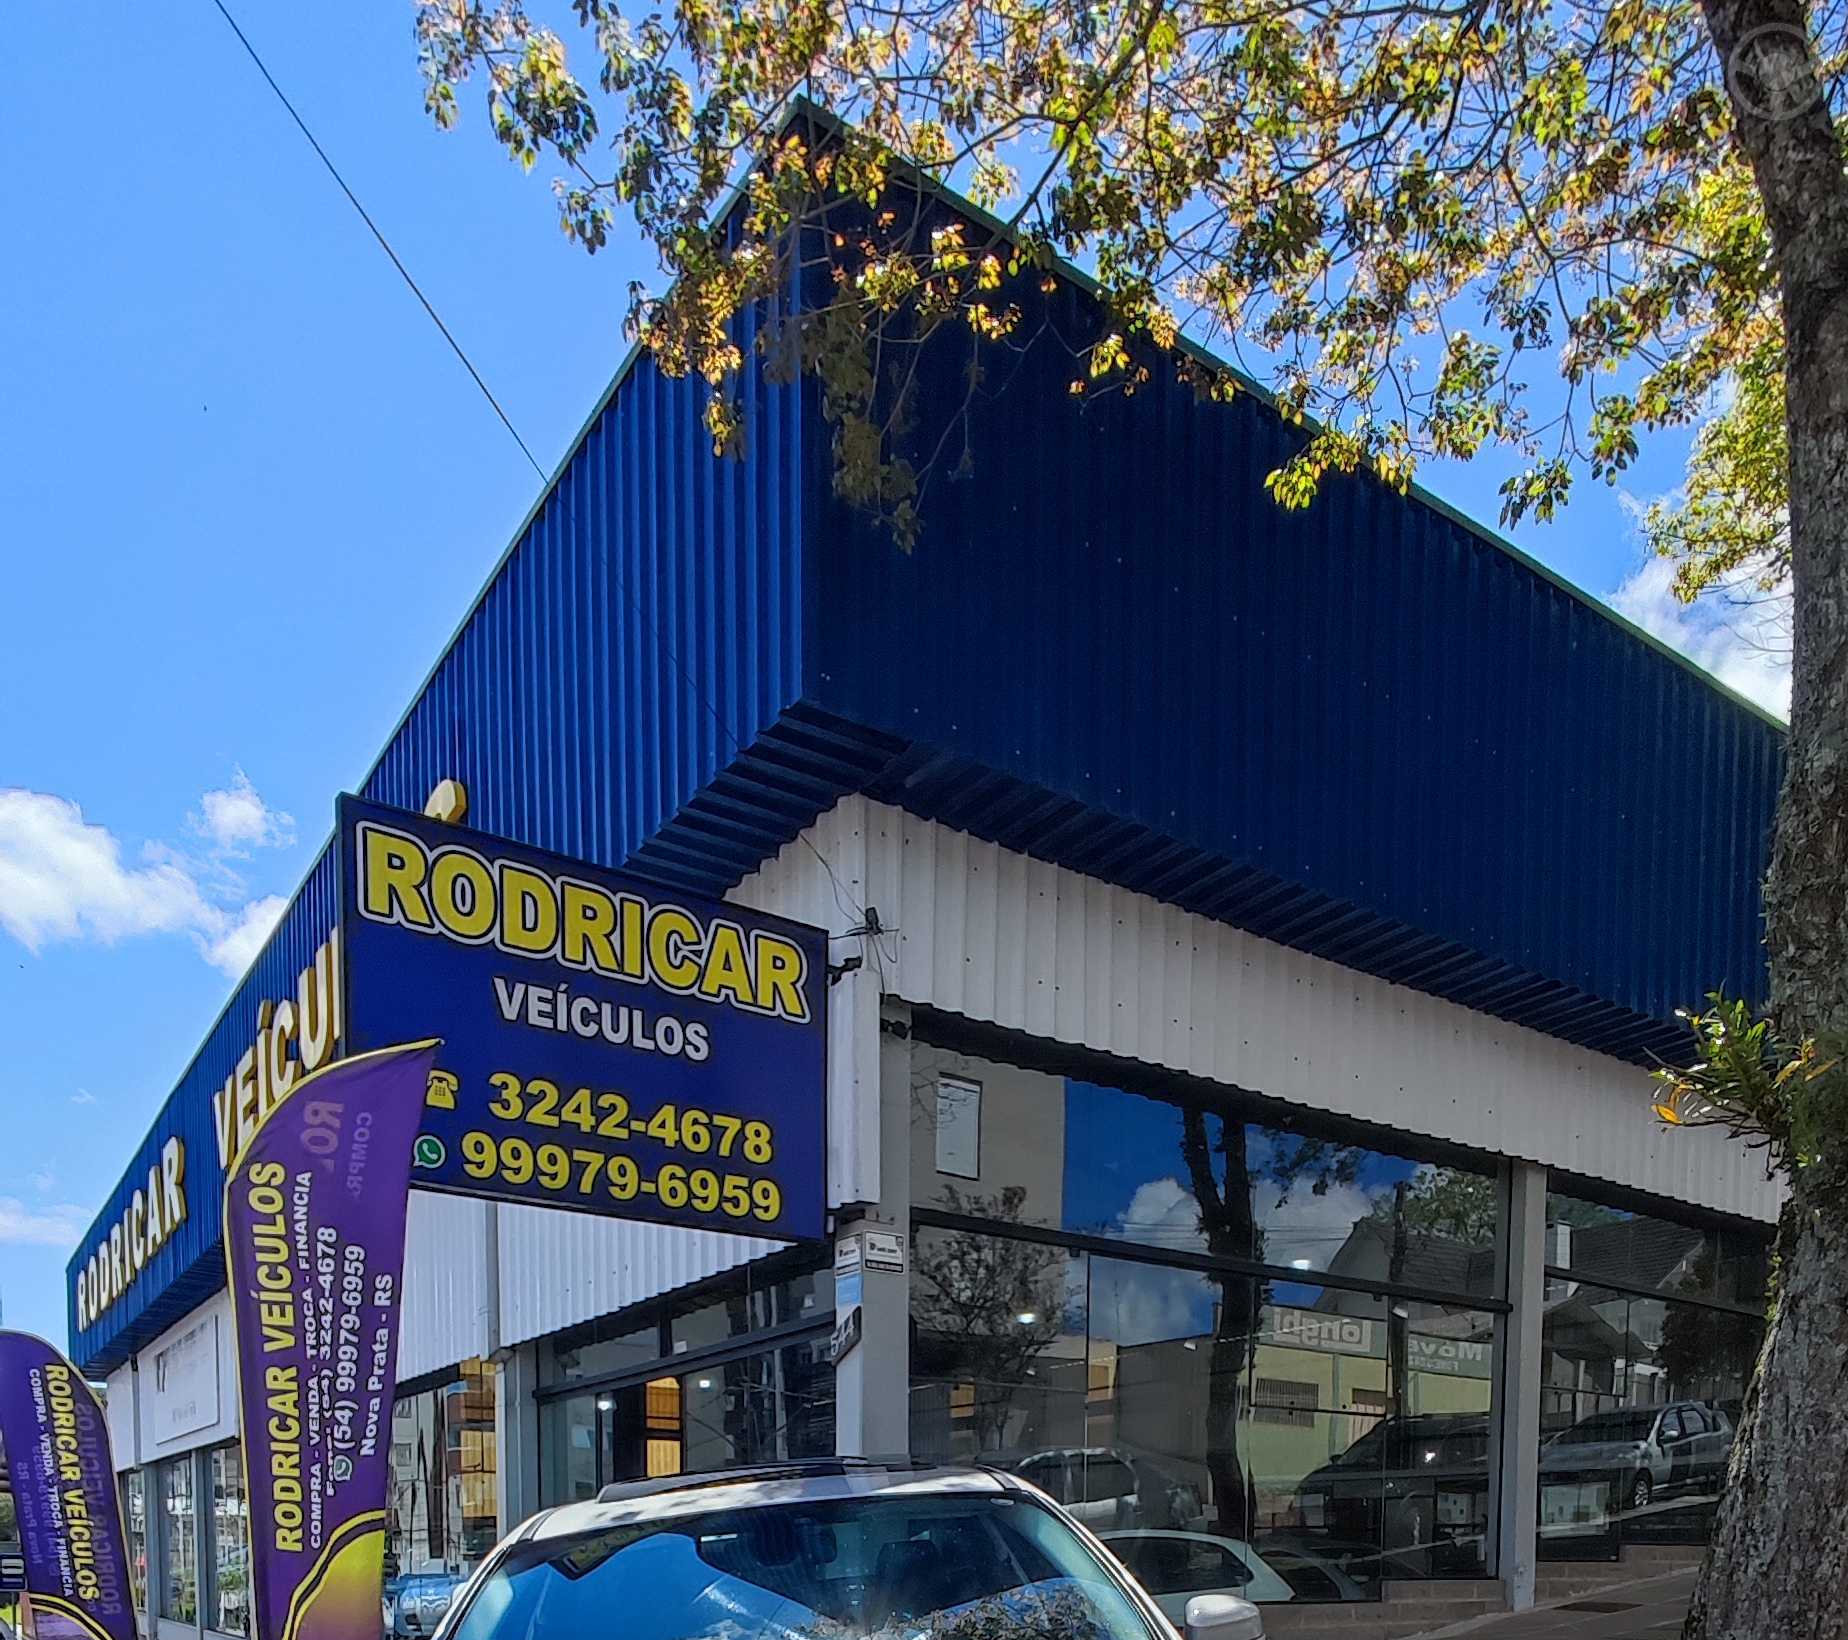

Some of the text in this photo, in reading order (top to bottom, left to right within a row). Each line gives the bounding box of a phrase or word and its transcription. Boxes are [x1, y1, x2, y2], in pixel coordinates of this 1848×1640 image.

[357, 822, 809, 1023] RODRICAR
[493, 976, 710, 1061] VEÍCULOS
[488, 1072, 774, 1164] 3242-4678
[292, 1171, 313, 1270] FINANCIA
[461, 1131, 782, 1221] 99979-6959
[77, 1136, 186, 1334] RODRICAR
[302, 1287, 319, 1360] TROCA
[316, 1226, 337, 1360] 3242-4678
[374, 1273, 393, 1307] RS
[248, 1162, 304, 1552] RODRICAR VEÍCULOS
[333, 1245, 366, 1450] (54) 99979-6959
[367, 1327, 390, 1391] Prata
[307, 1375, 321, 1446] VENDA
[360, 1397, 381, 1457] Nova
[29, 1368, 48, 1424] COMPRA
[39, 1433, 55, 1476] VENDA
[47, 1485, 64, 1529] TROCA
[56, 1537, 74, 1597] FINANCIA
[44, 1364, 101, 1600] RODRICAR VEÍCULOS
[309, 1462, 322, 1549] COMPRA
